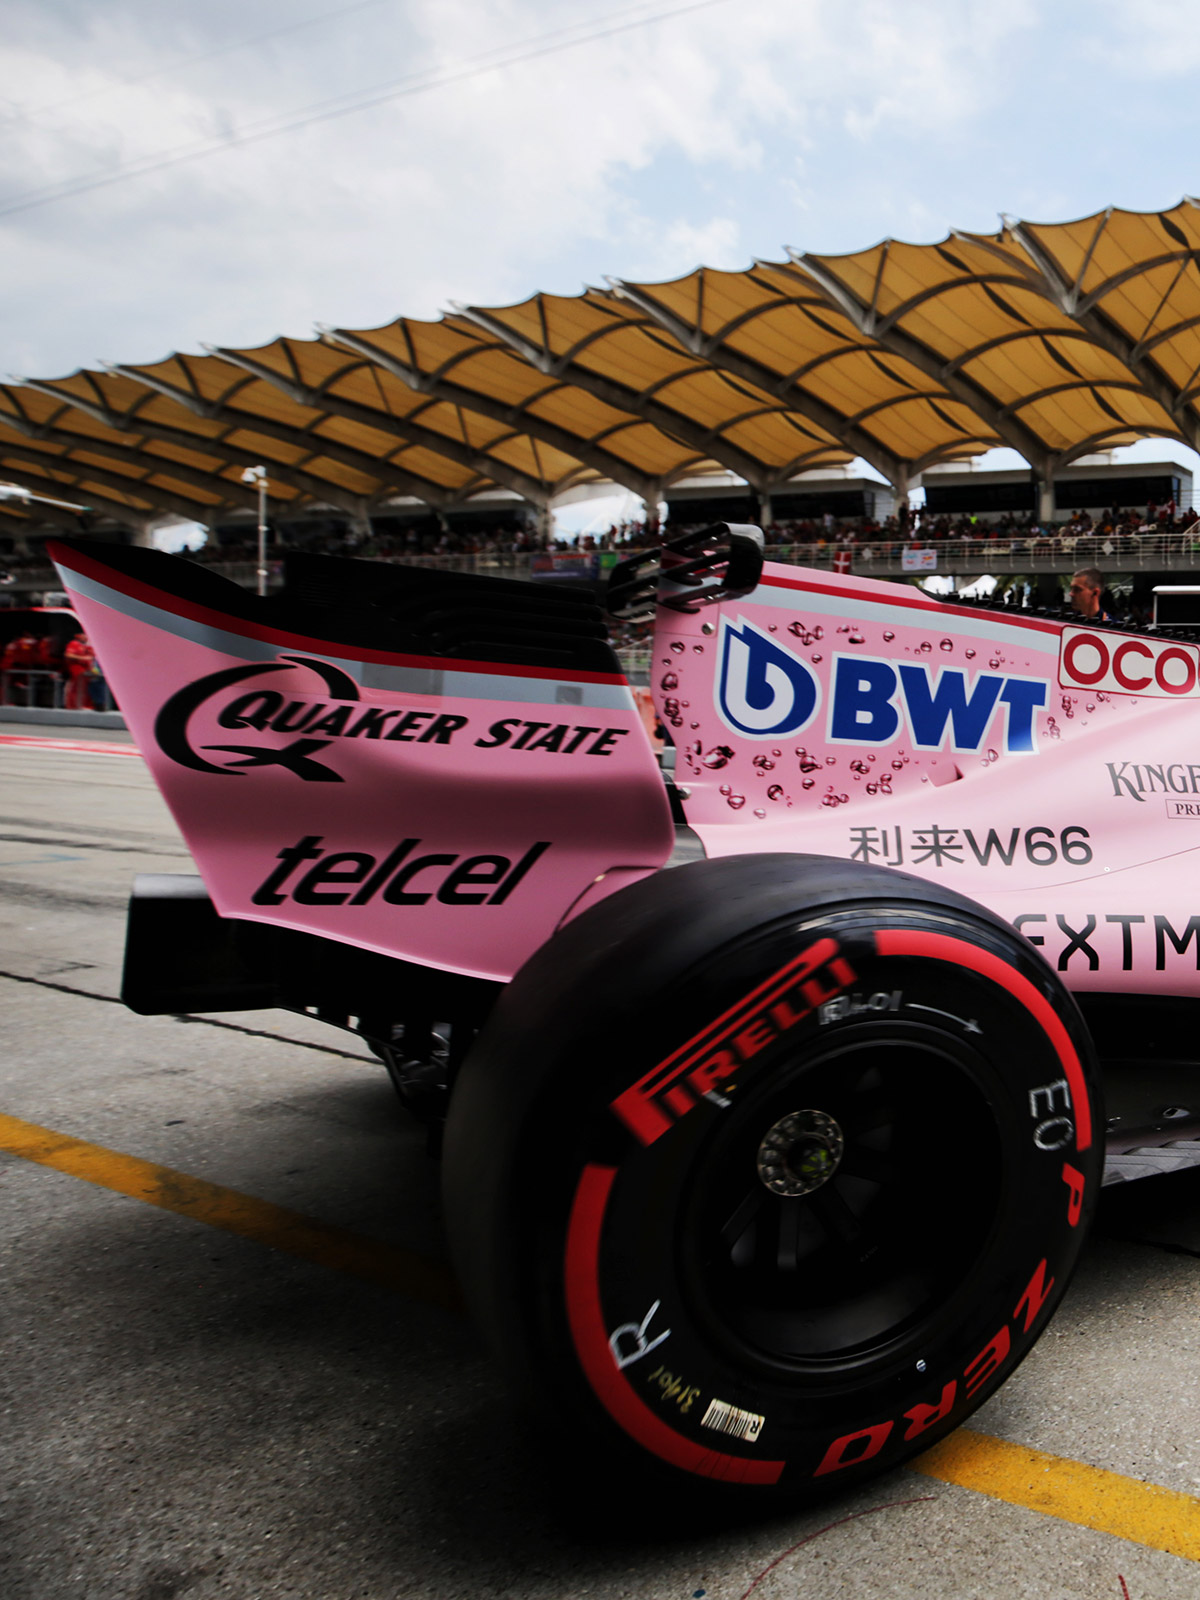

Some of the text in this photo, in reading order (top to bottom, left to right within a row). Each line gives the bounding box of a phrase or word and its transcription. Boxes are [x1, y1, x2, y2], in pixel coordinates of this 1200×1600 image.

[1062, 632, 1197, 695] OCO
[217, 690, 629, 757] QUAKER STATE
[831, 655, 1049, 753] BWT
[251, 836, 553, 906] telcel
[848, 825, 1094, 868] 利来W66
[609, 937, 859, 1148] PIRELLI
[608, 1298, 671, 1370] R
[813, 1257, 1055, 1477] ZERO
